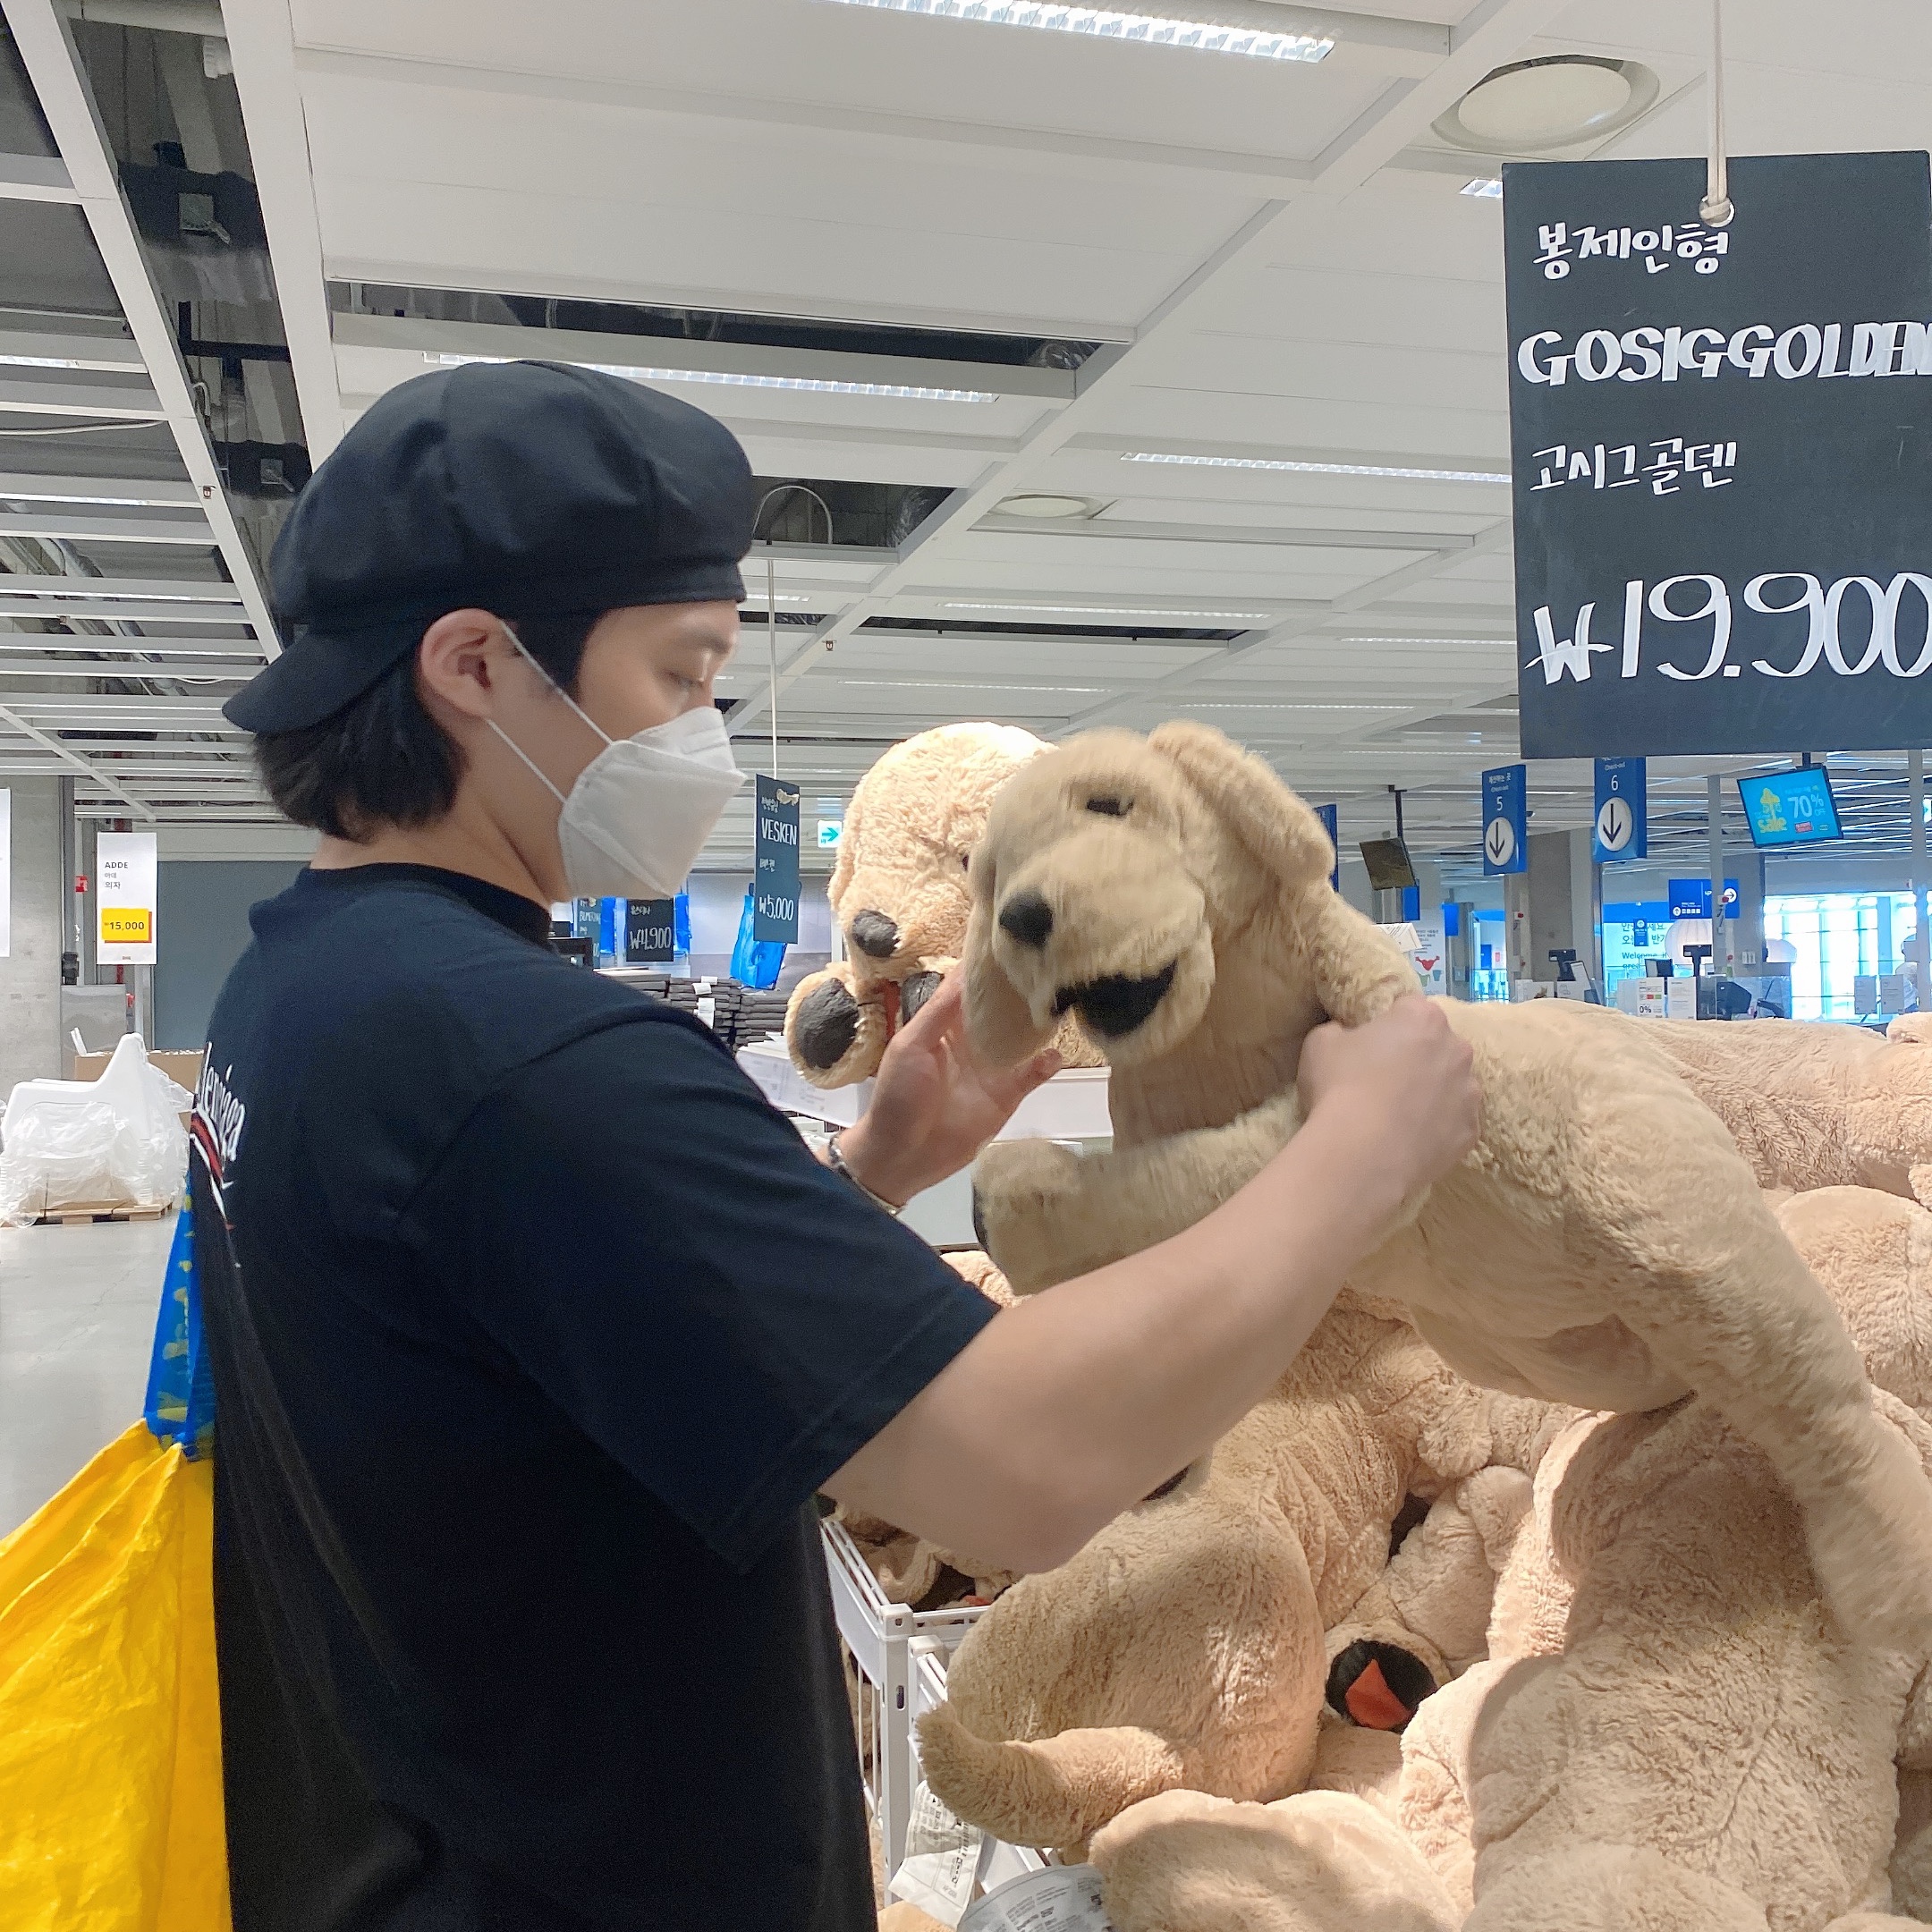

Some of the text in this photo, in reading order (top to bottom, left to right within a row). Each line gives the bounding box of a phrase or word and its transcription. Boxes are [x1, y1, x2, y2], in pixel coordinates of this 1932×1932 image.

[1533, 222, 1728, 280] 봉제인형
[1530, 437, 1737, 496] 고시그골덴
[1611, 775, 1619, 791] 6
[1496, 796, 1503, 811] 5
[761, 817, 797, 845] VESKEN
[105, 861, 129, 869] ADDE
